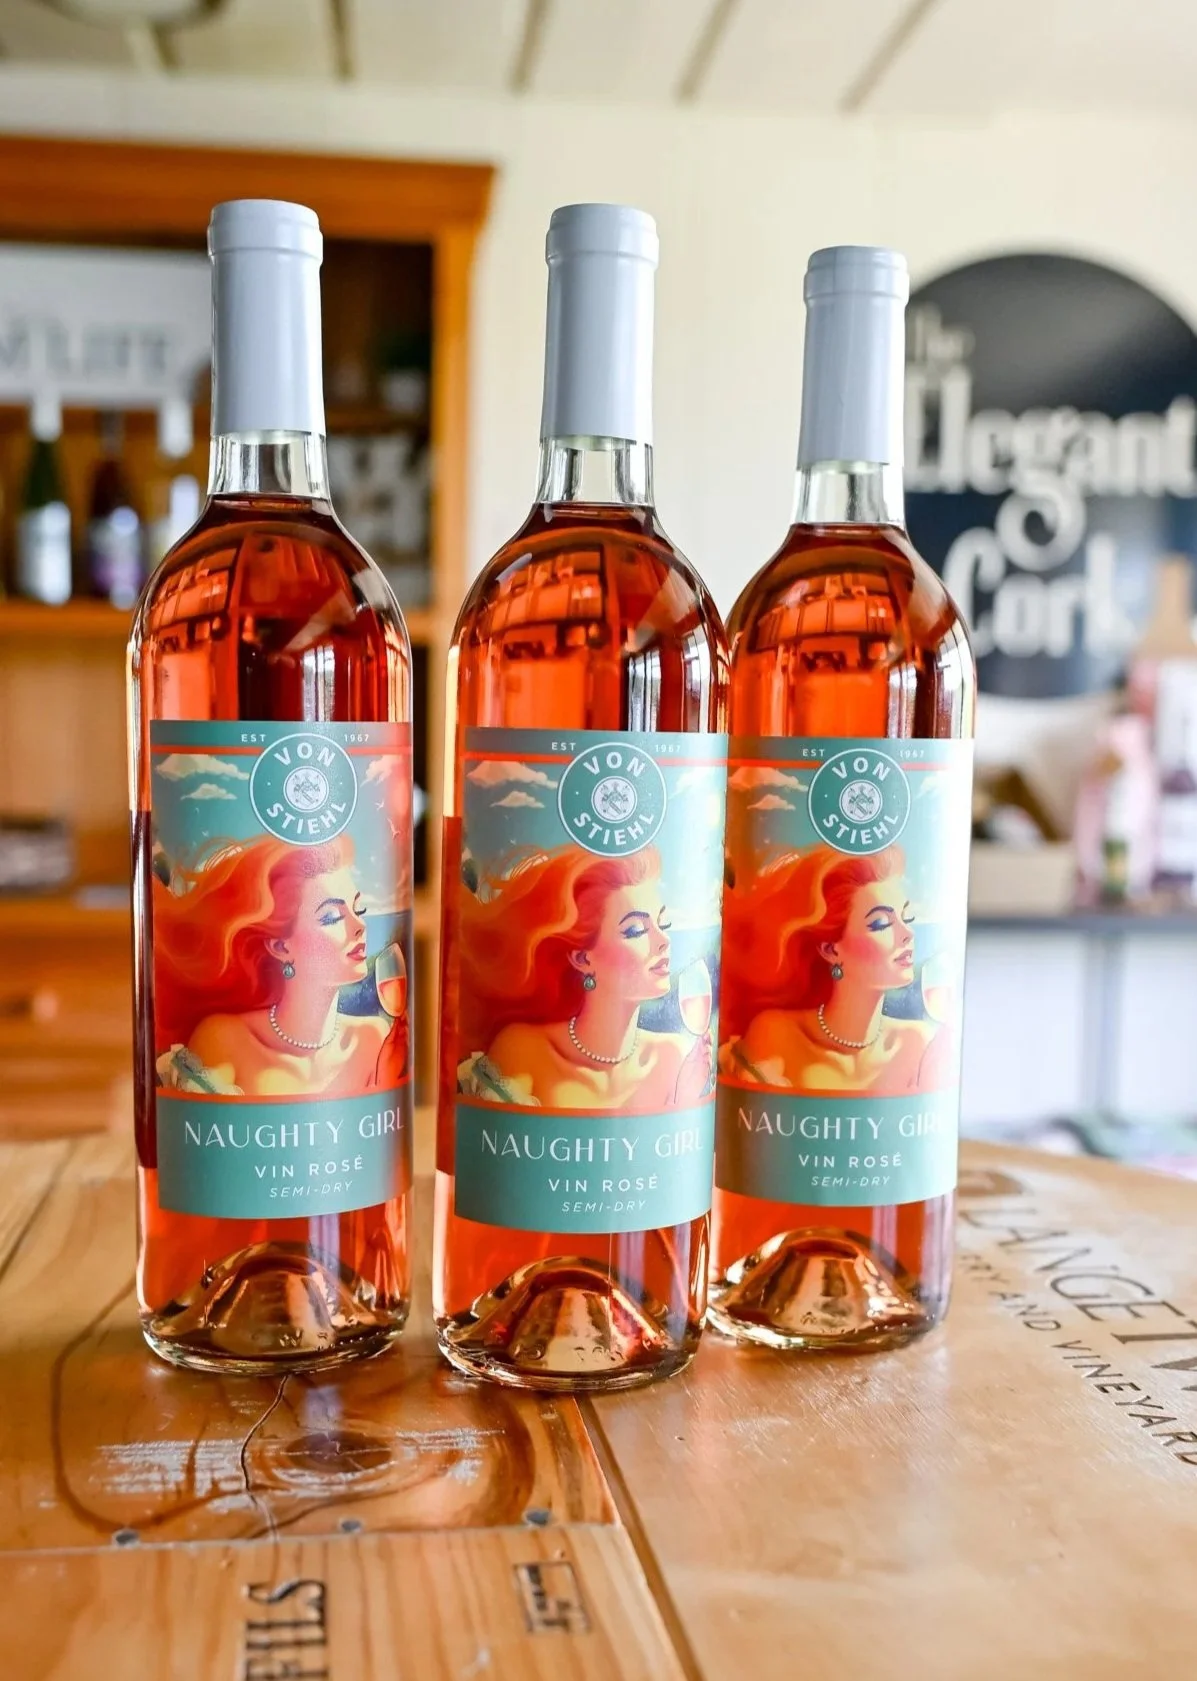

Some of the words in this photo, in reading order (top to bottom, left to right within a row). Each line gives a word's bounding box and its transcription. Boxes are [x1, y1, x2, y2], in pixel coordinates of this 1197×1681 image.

[241, 734, 266, 743] EST
[344, 734, 369, 743] 1967
[551, 742, 577, 751] EST
[654, 744, 682, 753] 1967
[274, 742, 336, 768] VON
[582, 752, 646, 778] VON
[802, 748, 825, 757] EST
[899, 749, 925, 758] 1967
[831, 757, 891, 781] VON
[266, 802, 346, 836] STIEHL
[573, 811, 655, 846] STIEHL
[822, 813, 899, 845] STIEHL
[184, 1119, 344, 1149] NAUGHTY
[358, 1107, 405, 1139] GIRL
[738, 1107, 885, 1140] NAUGHTY
[481, 1129, 640, 1163] NAUGHTY
[654, 1127, 705, 1158] GIRL
[254, 1165, 295, 1179] VIN
[309, 1154, 365, 1177] ROSÉ
[798, 1154, 836, 1168] VIN
[848, 1151, 903, 1168] ROSÉ
[269, 1180, 353, 1198] SEMI-DRY
[548, 1178, 588, 1193] VIN
[602, 1173, 658, 1193] ROSÉ
[810, 1175, 891, 1187] SEMI-DRY
[561, 1200, 648, 1213] SEMI-DRY
[988, 1290, 1063, 1332] AND
